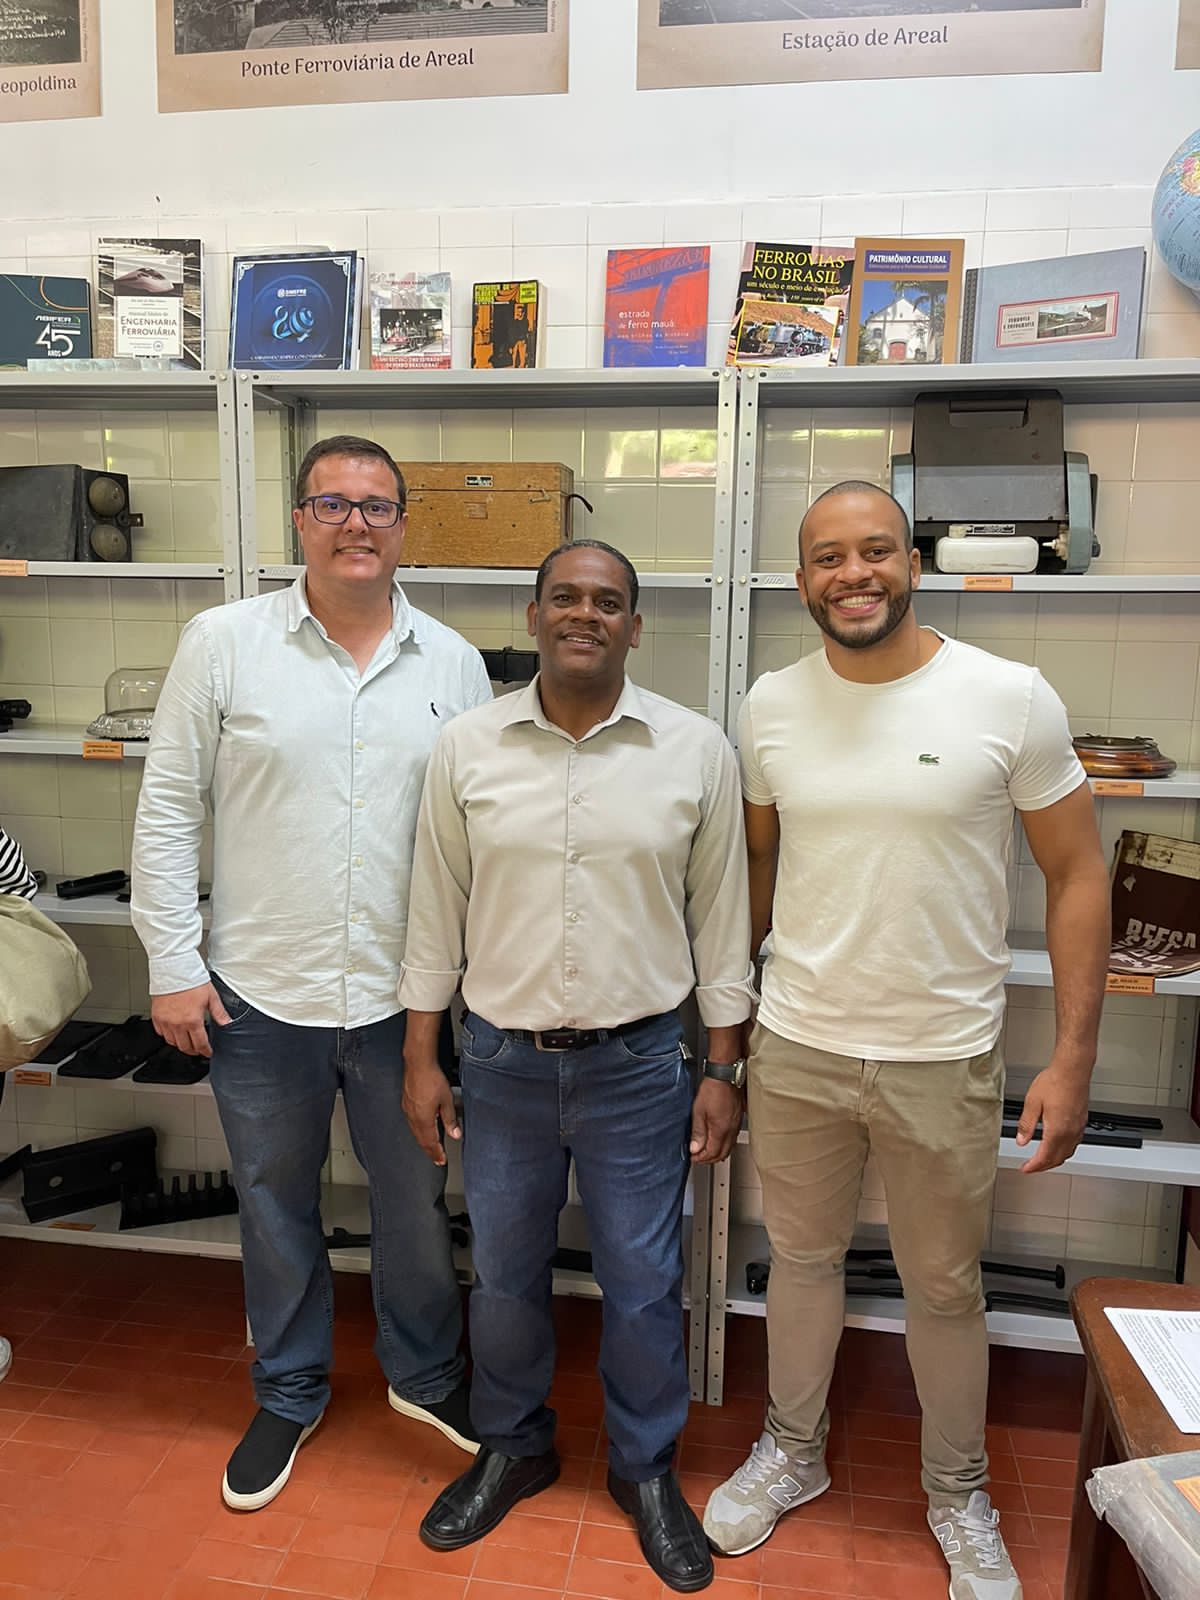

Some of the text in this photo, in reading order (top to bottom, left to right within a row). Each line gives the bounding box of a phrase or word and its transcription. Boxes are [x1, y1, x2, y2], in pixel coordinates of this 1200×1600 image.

[782, 25, 949, 52] Estação de Areal
[241, 48, 474, 77] Ponte Ferroviária de Areal
[0, 75, 77, 96] eopoldina
[754, 249, 846, 269] FERROVIAS
[869, 253, 947, 264] PATRIMÔNIO CULTURAL
[752, 265, 840, 284] NO BRASIL
[759, 281, 779, 290] século
[120, 315, 177, 326] ENGENHARIA
[618, 309, 650, 319] estrada
[121, 326, 176, 336] FERROVIÁRIA
[628, 319, 649, 329] ferro
[651, 319, 674, 329] mauá
[35, 322, 81, 356] 45
